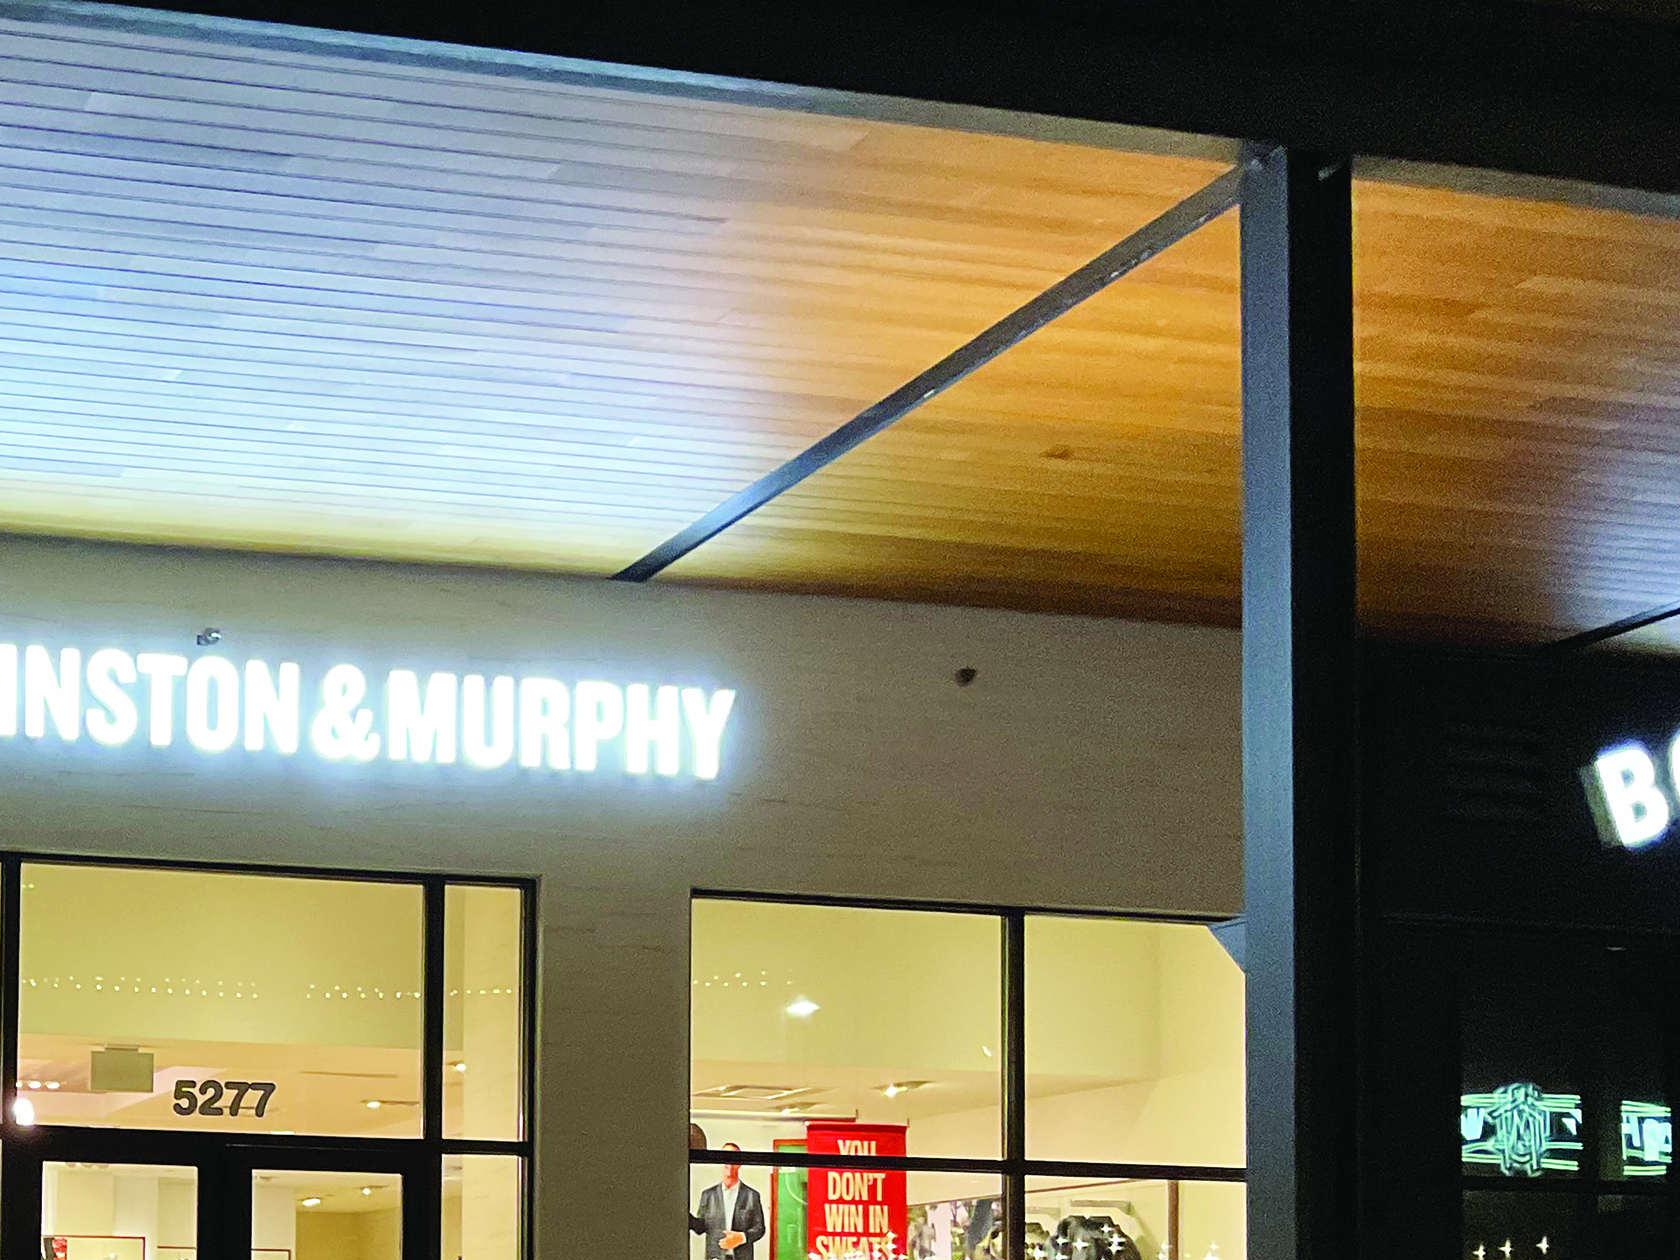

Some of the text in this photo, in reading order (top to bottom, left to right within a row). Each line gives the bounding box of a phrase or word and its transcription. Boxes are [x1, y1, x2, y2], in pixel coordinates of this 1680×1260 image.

[172, 1079, 277, 1118] 5277
[827, 1171, 887, 1202] DON'T
[824, 1203, 890, 1234] WIN IN
